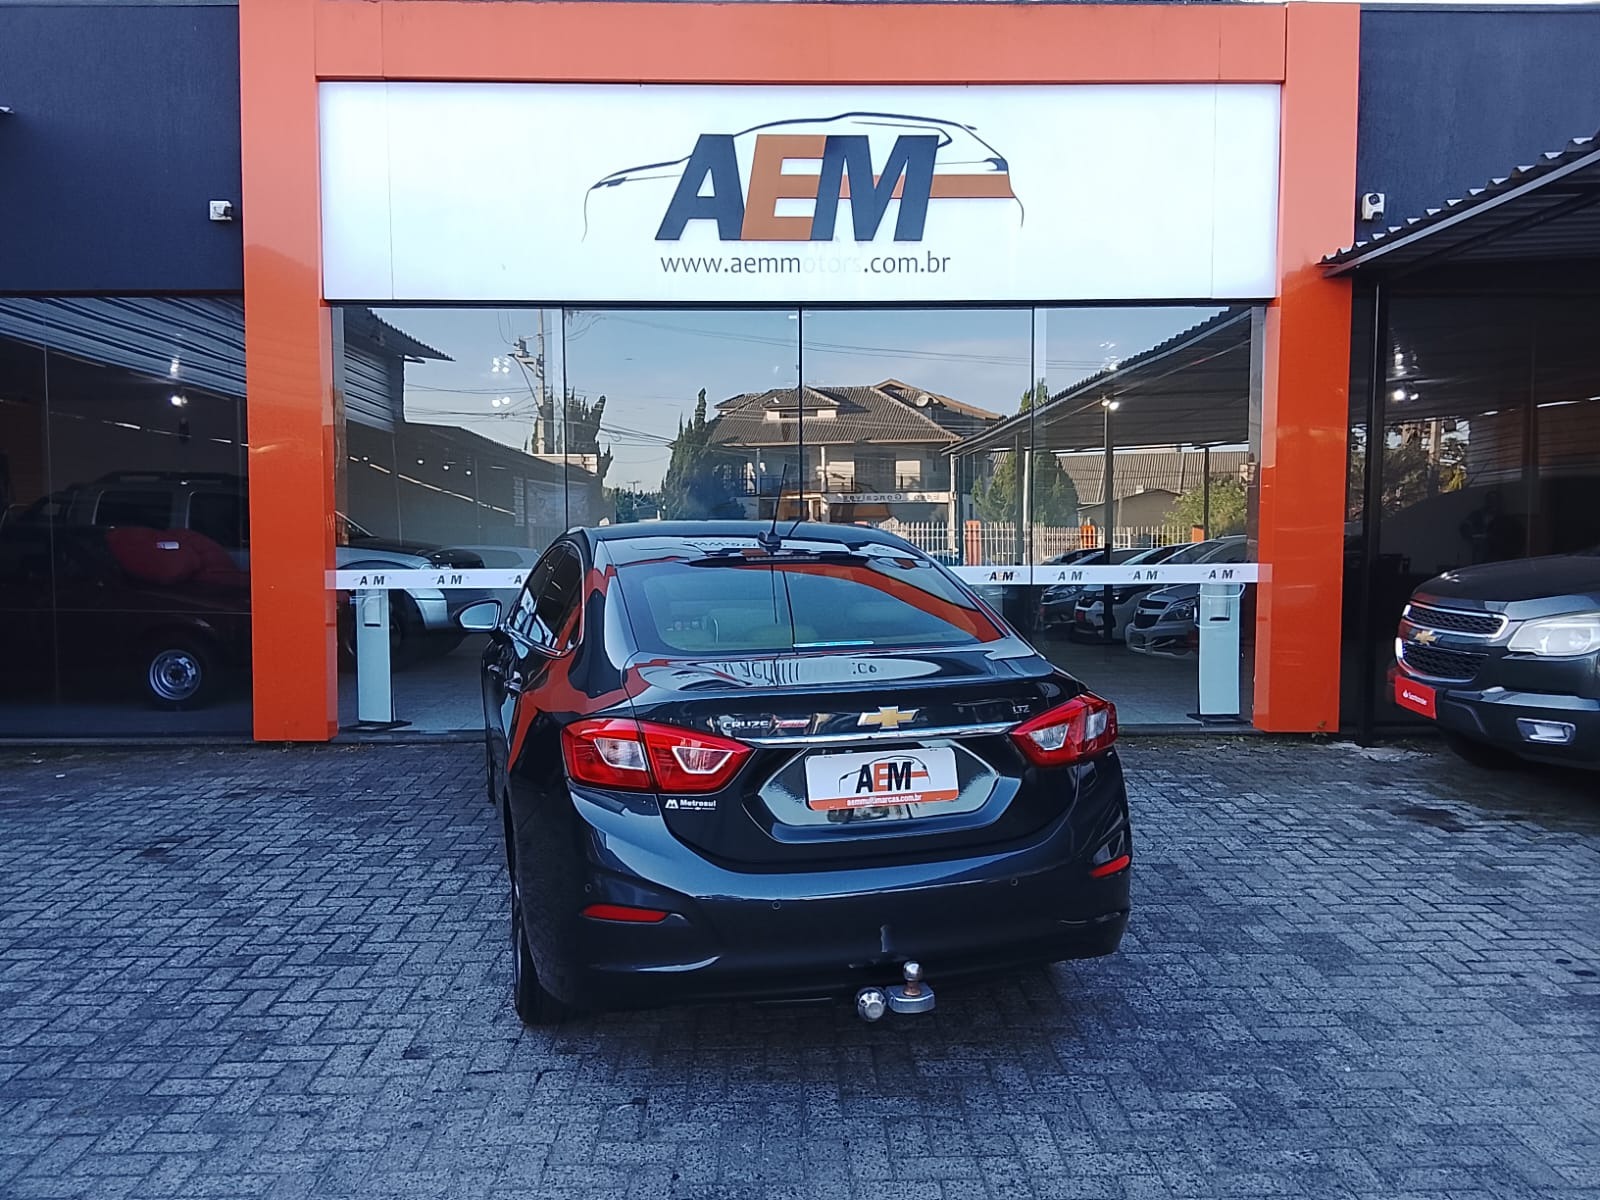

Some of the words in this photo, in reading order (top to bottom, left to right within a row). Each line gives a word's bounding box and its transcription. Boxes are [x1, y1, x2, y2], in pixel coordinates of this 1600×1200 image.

[655, 134, 940, 241] AEM
[1012, 704, 1031, 714] LTZ
[723, 720, 769, 730] CRUZE
[855, 761, 913, 795] AEM
